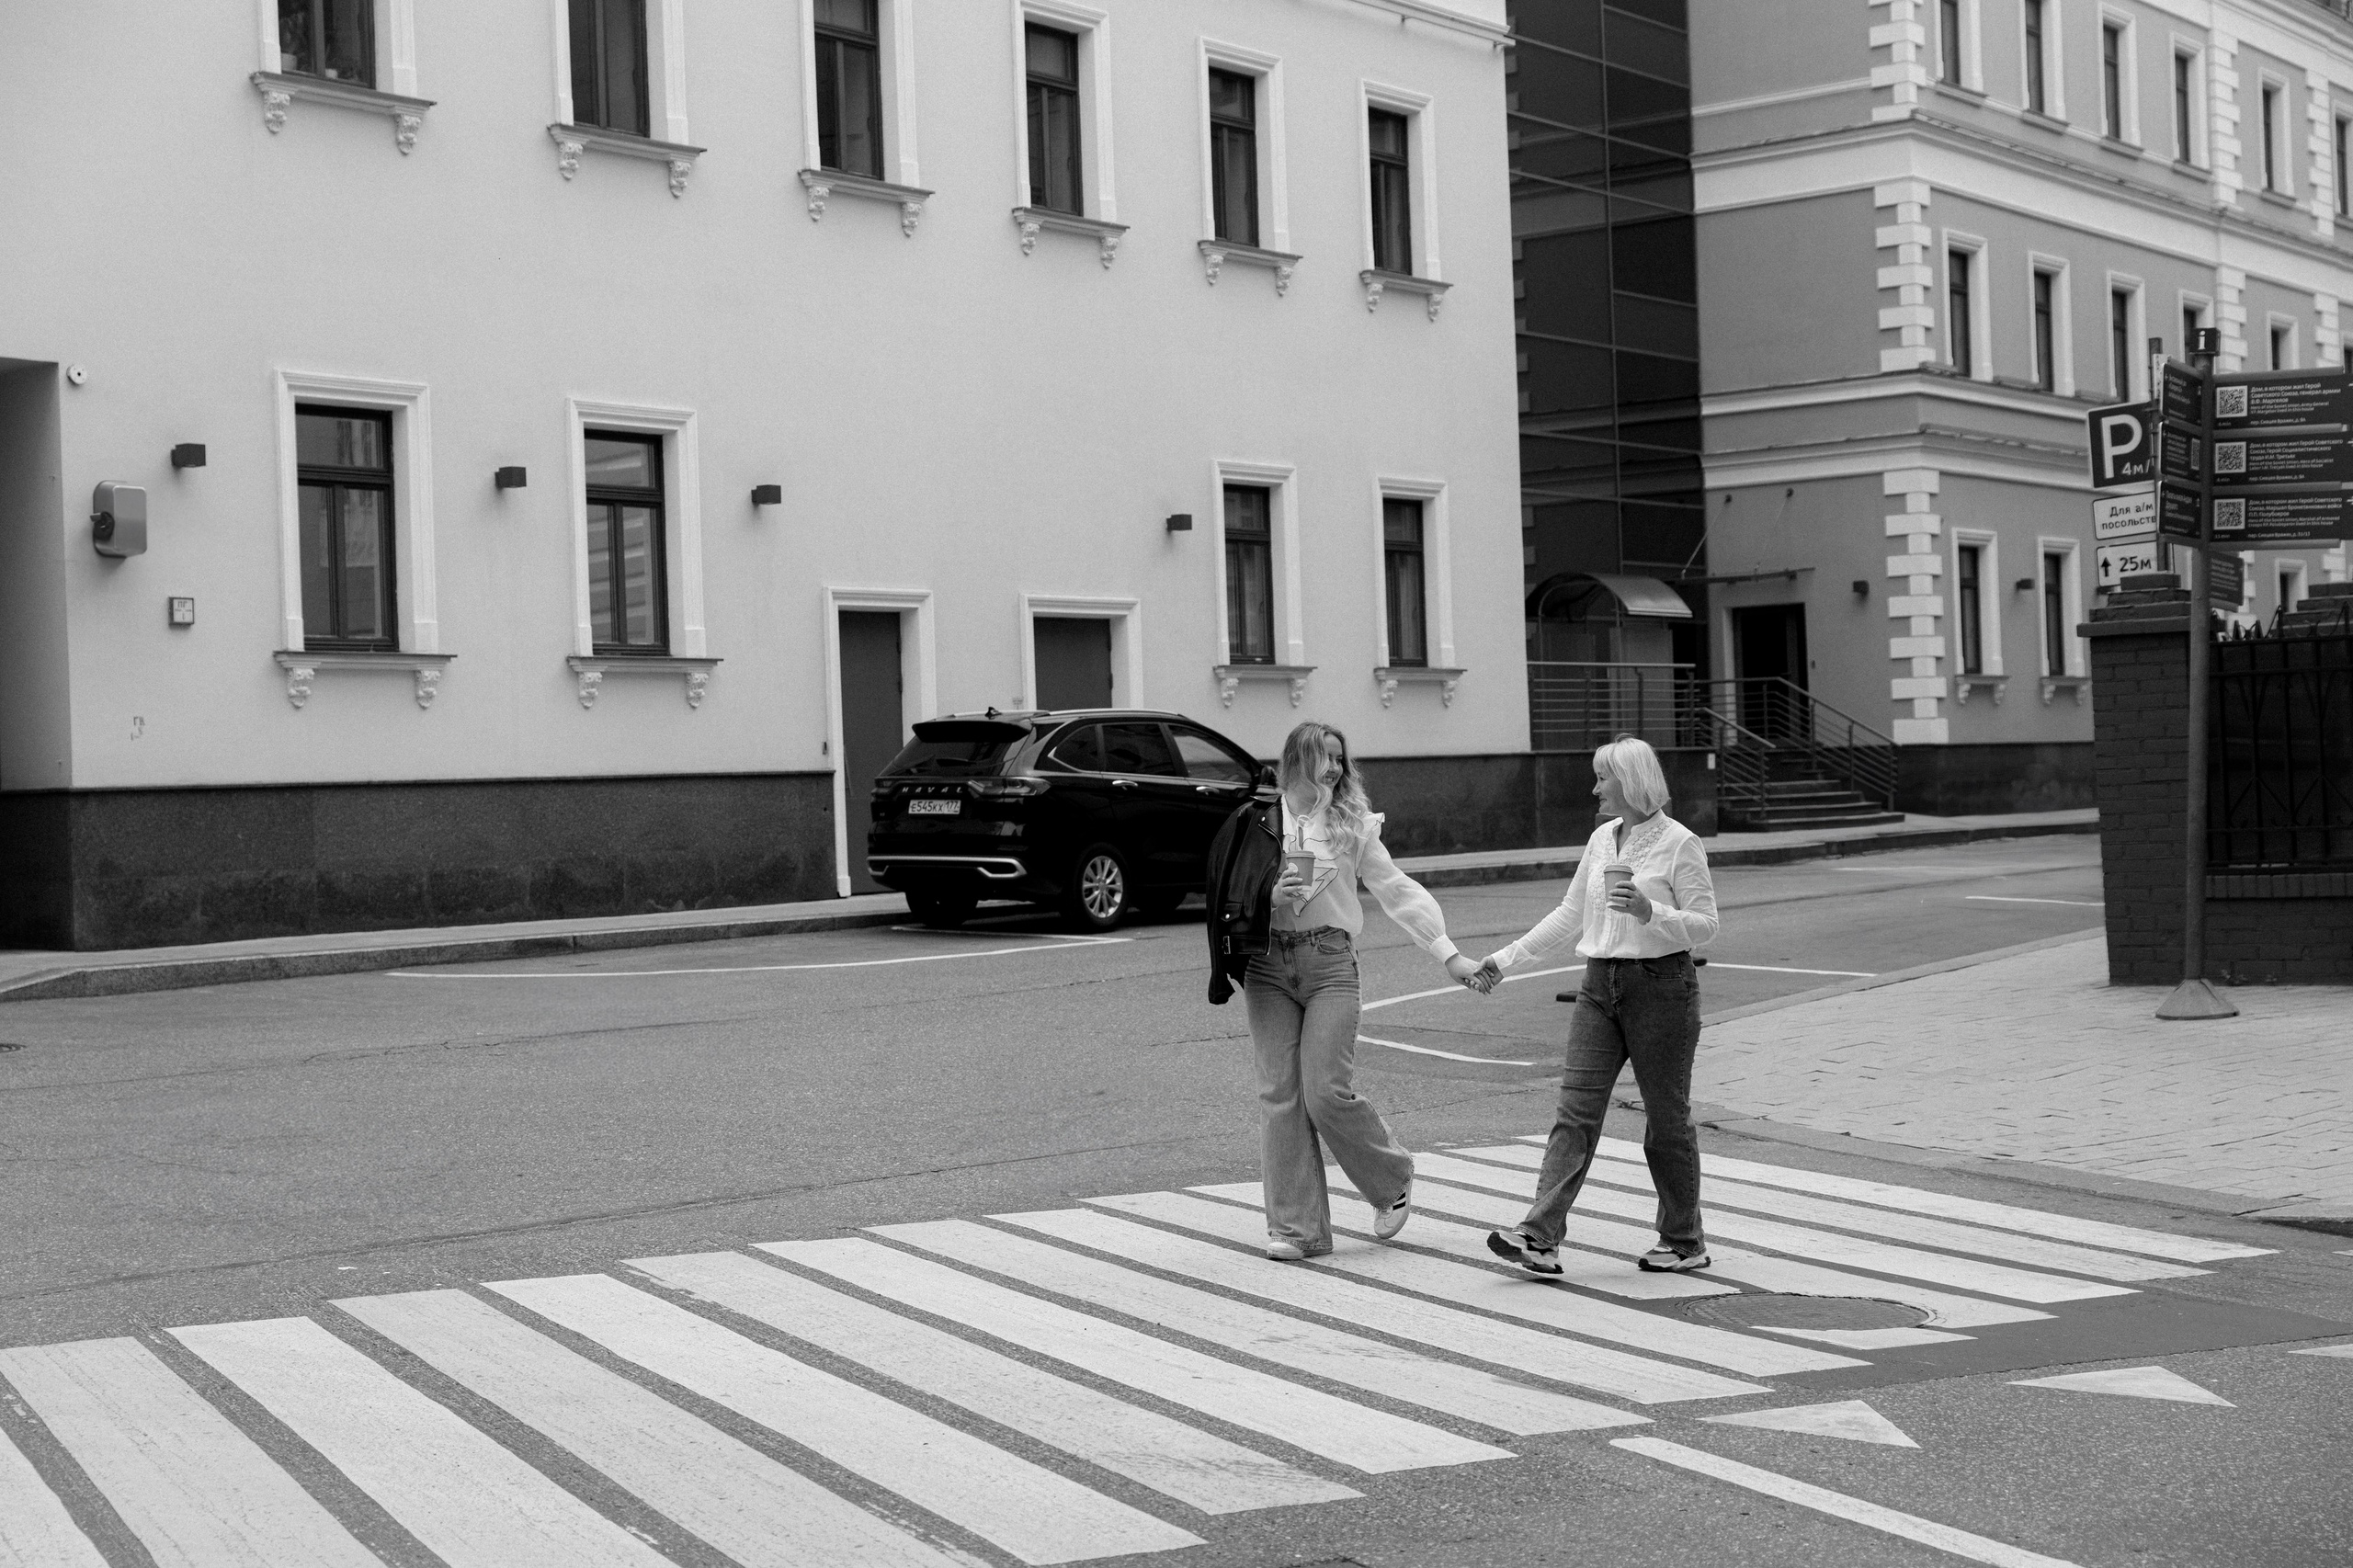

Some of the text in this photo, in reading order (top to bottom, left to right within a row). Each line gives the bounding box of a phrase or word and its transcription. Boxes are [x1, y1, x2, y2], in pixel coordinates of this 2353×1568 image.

[2101, 414, 2143, 479] P
[2109, 506, 2131, 517] Для
[2135, 502, 2154, 513] а/м
[2101, 515, 2157, 530] посольств
